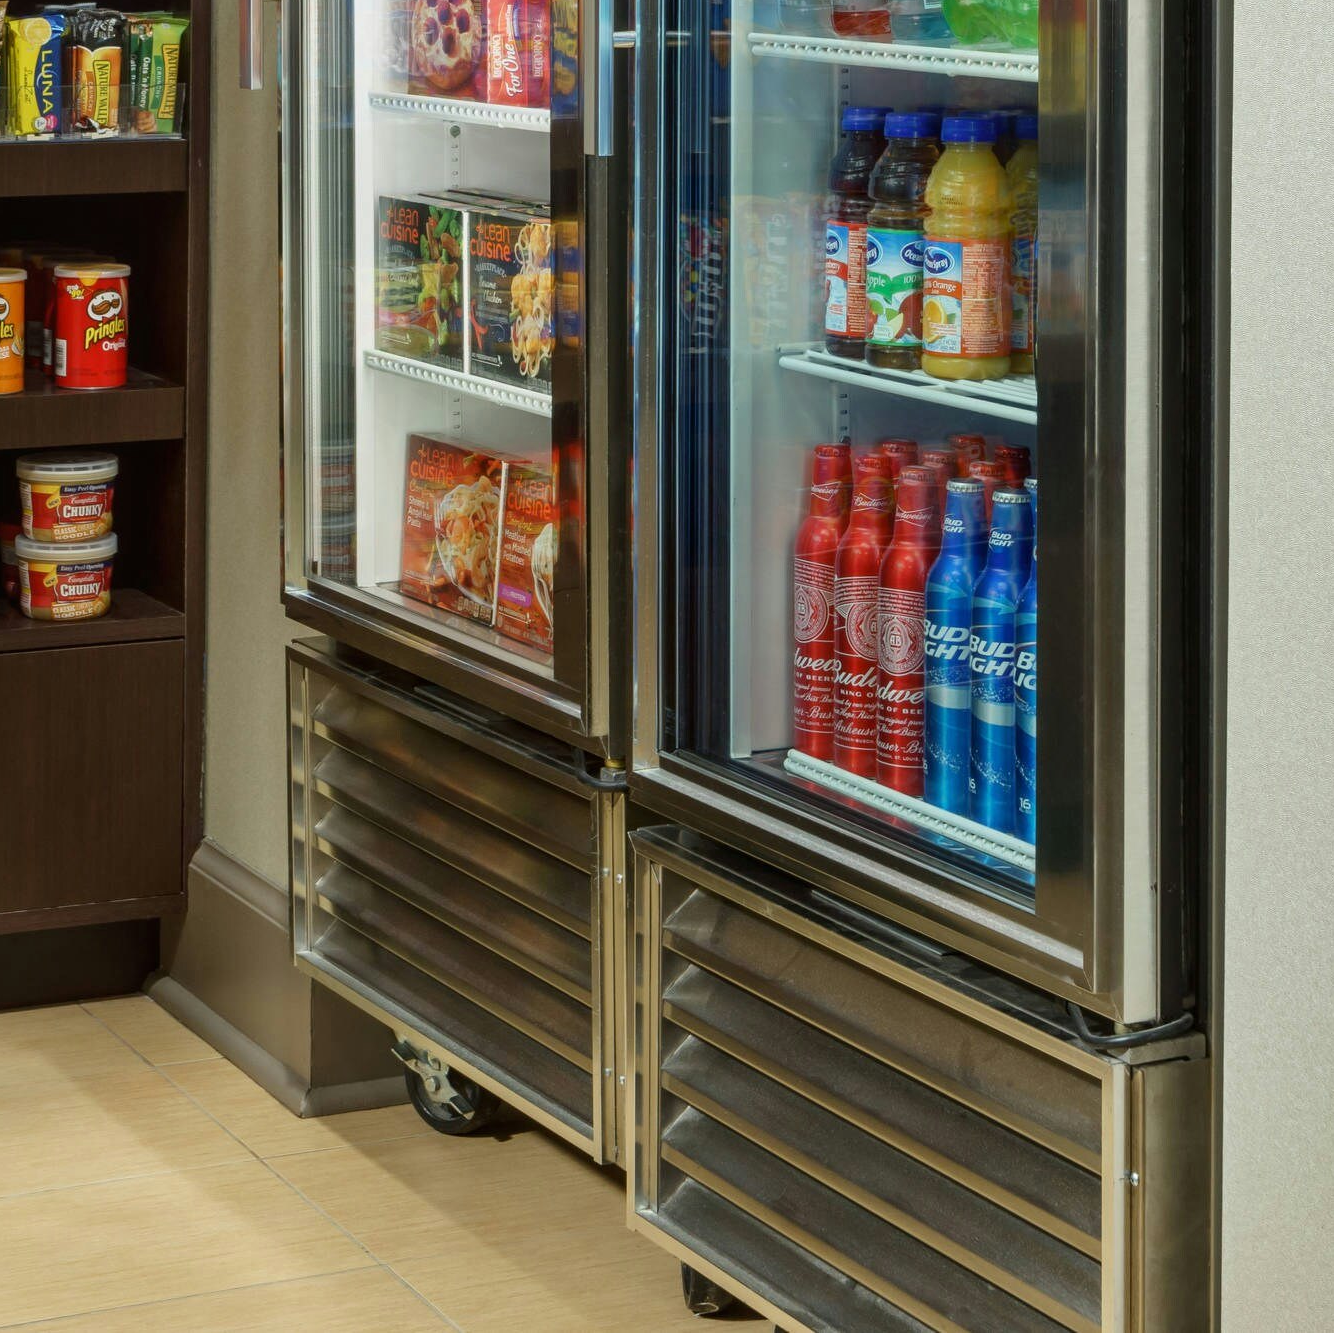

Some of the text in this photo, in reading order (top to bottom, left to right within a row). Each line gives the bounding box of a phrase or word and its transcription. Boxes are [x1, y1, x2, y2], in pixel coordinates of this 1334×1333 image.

[165, 47, 178, 85] NATURE
[41, 50, 53, 114] LUNA
[95, 63, 109, 96] NATURE
[932, 281, 956, 292] Orange
[85, 318, 125, 349] Pringles
[63, 504, 103, 518] CHUNKY
[991, 531, 1011, 540] BUD
[60, 582, 100, 596] CHUNKY
